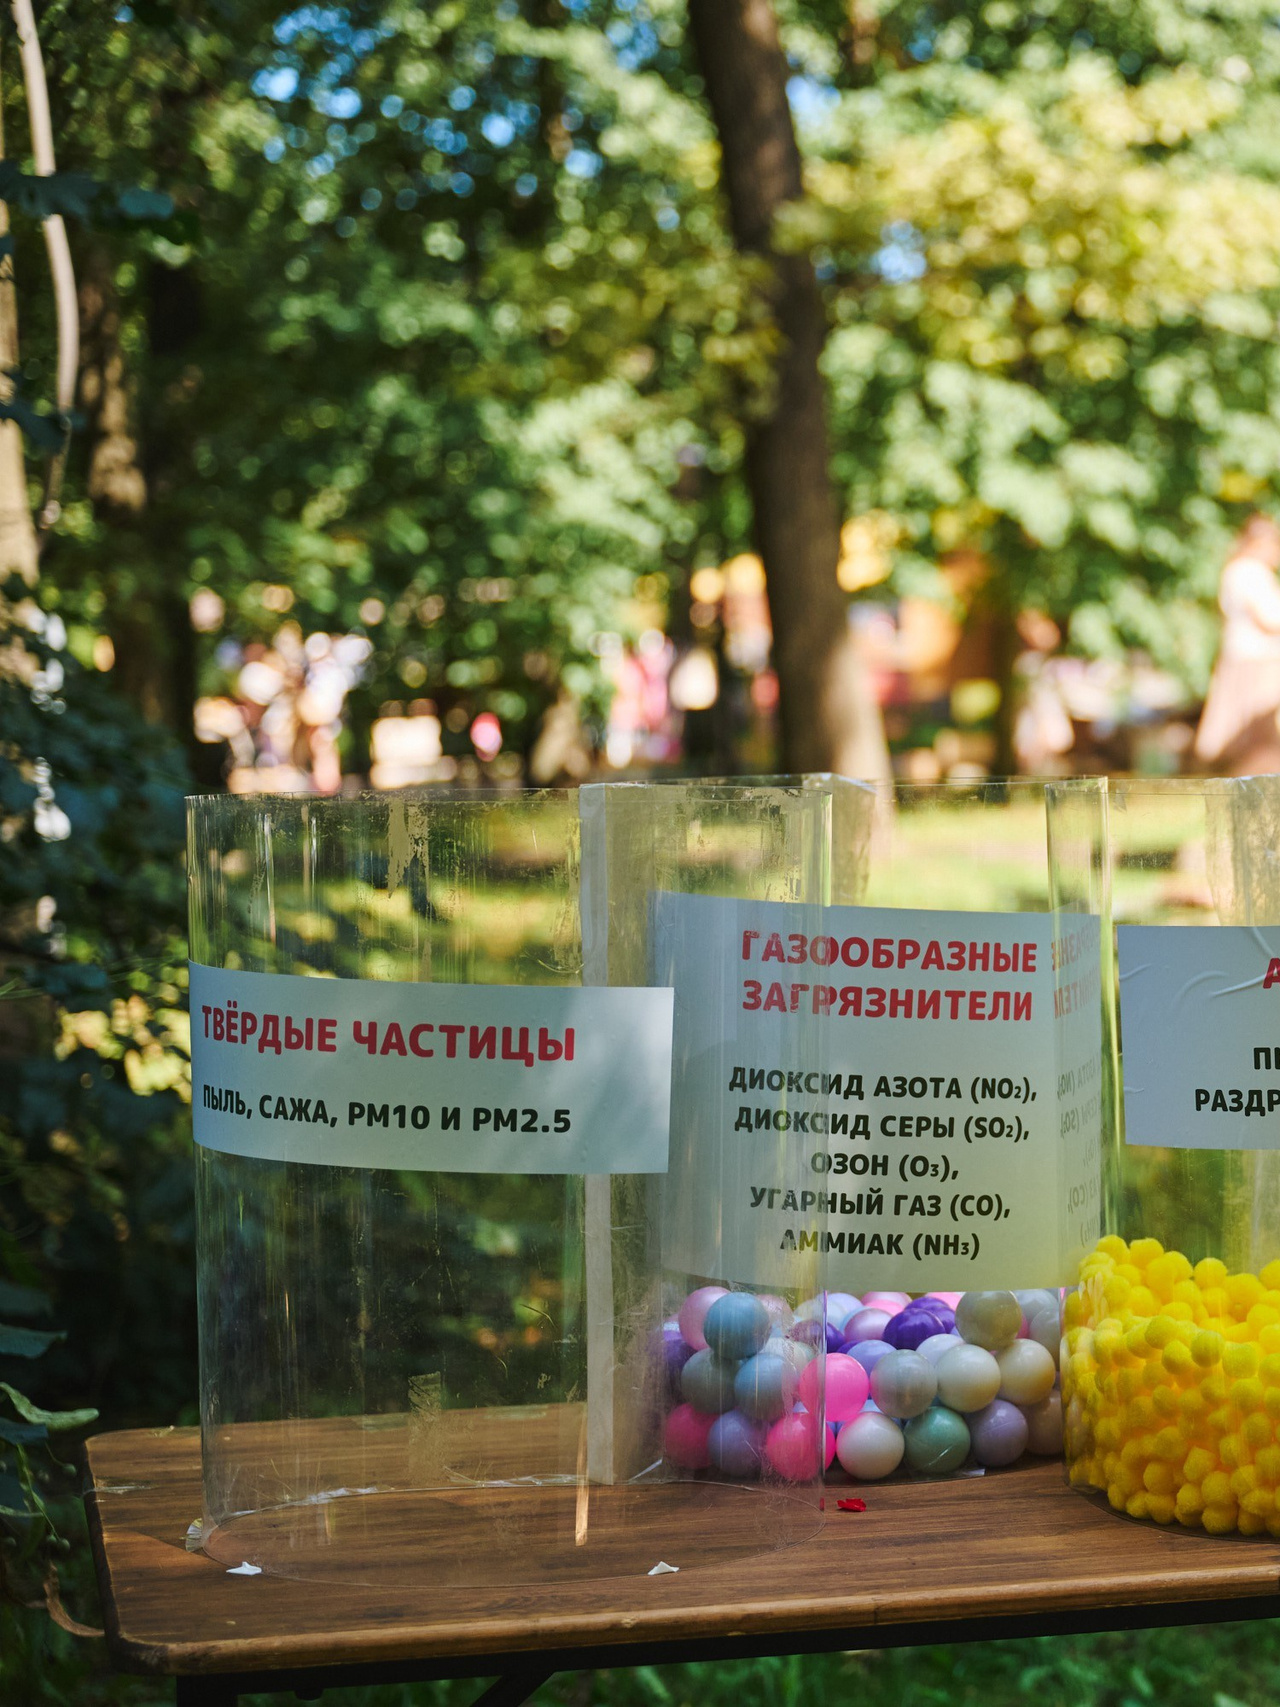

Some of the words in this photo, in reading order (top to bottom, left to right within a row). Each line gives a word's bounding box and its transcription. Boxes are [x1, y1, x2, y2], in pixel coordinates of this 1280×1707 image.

[742, 930, 1037, 972] ГАЗООБРАЗНЫЕ
[742, 980, 1033, 1021] ЗАГРЯЗНИТЕЛИ
[201, 1000, 338, 1054] ТВЁРДЫЕ
[352, 1020, 575, 1067] ЧАСТИЦЫ
[729, 1066, 864, 1100] ДИОКСИД
[874, 1076, 962, 1099] АЗОТА
[203, 1084, 253, 1120] ПЫЛЬ,
[258, 1094, 339, 1127] САЖА,
[441, 1107, 461, 1131] И
[734, 1106, 871, 1140] ДИОКСИД
[880, 1115, 955, 1138] СЕРЫ
[811, 1151, 888, 1176] ОЗОН
[749, 1186, 884, 1215] УГАРНЫЙ
[893, 1195, 941, 1217] ГАЗ
[780, 1229, 903, 1255] АММИАК
